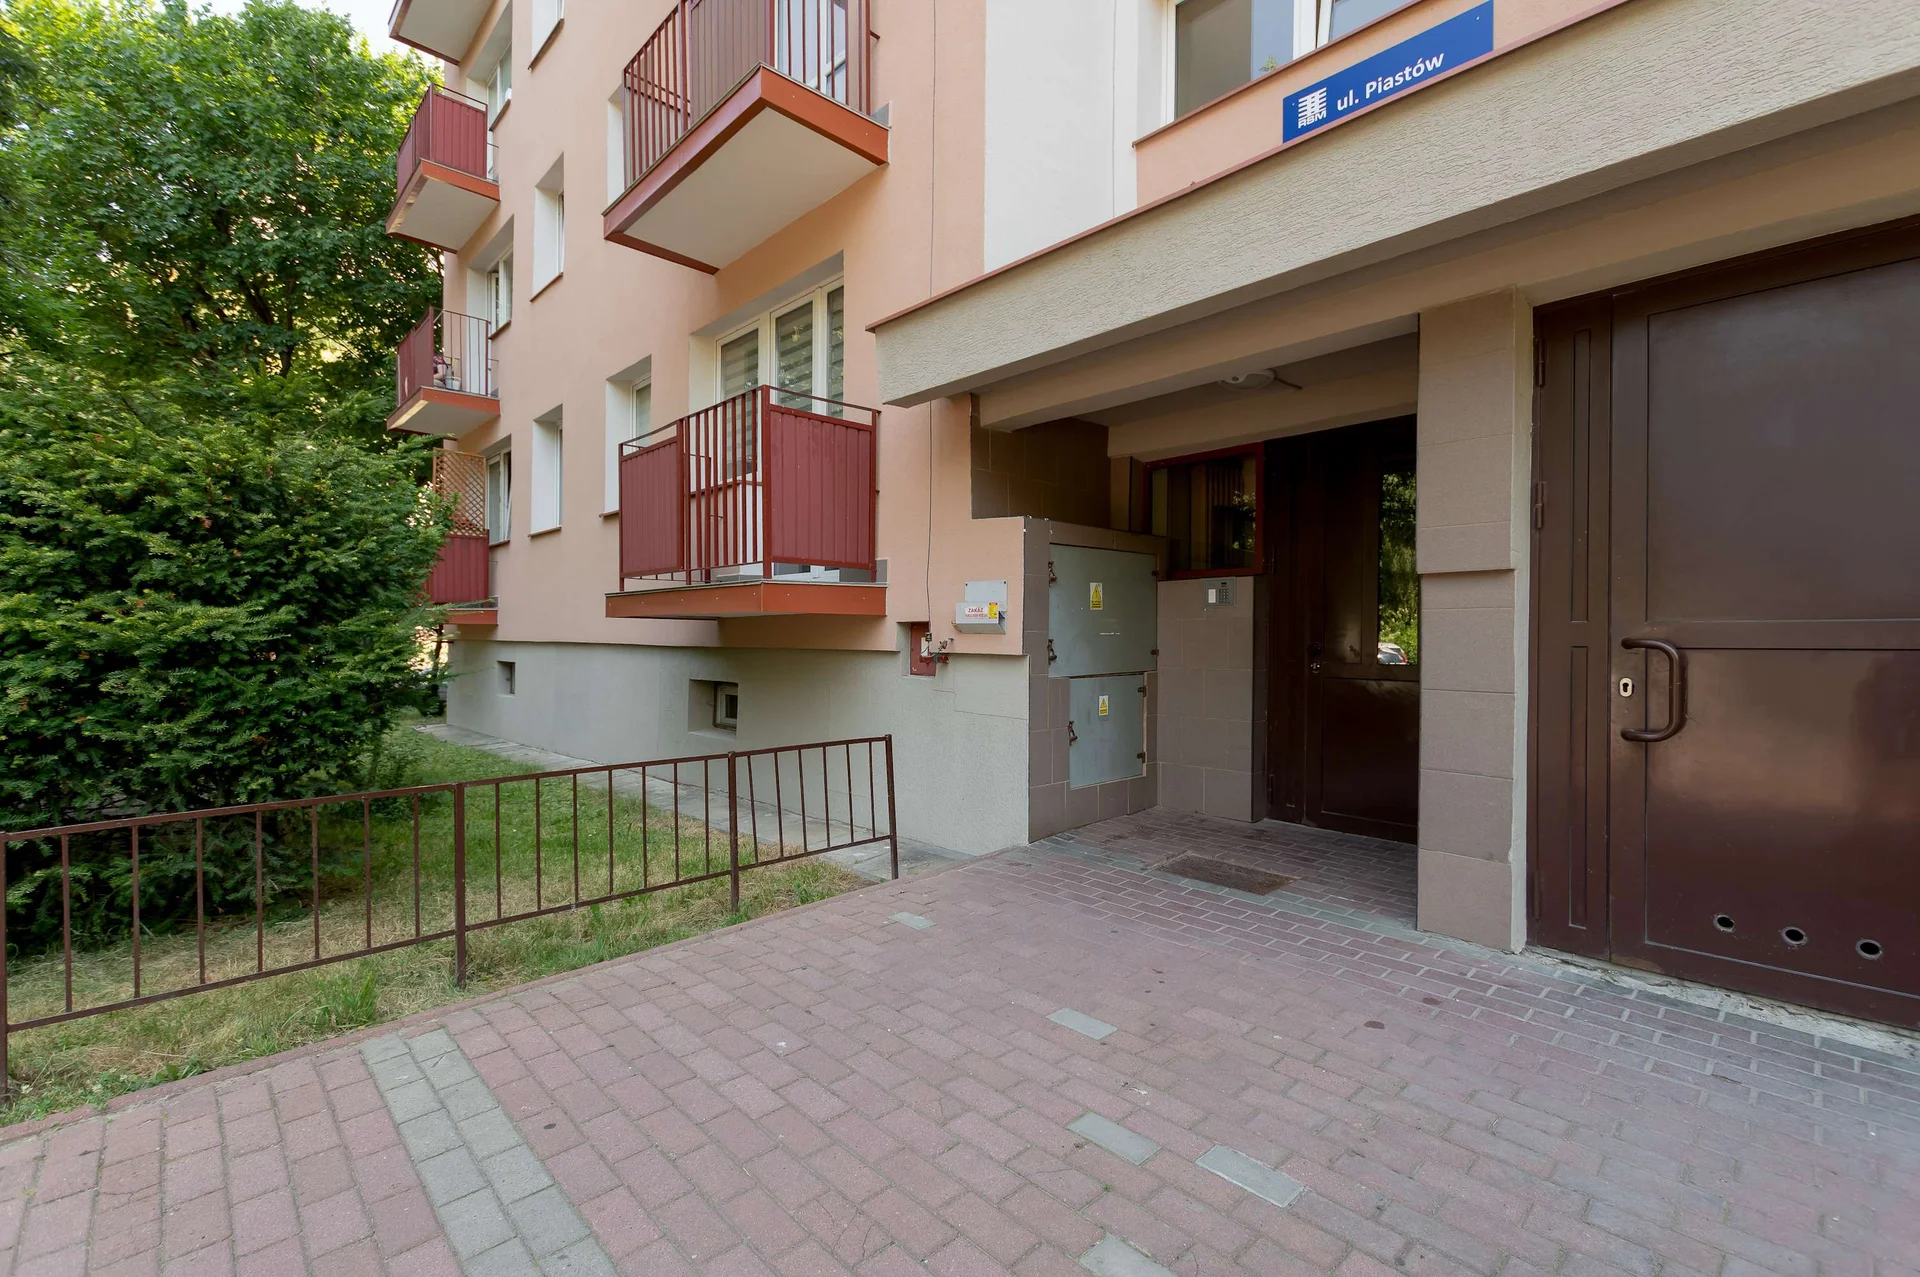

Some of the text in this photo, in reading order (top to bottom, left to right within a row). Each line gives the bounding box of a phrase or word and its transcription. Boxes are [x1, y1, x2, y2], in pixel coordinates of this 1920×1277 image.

[1337, 53, 1445, 111] ul. Piastów
[1297, 109, 1327, 129] RSM
